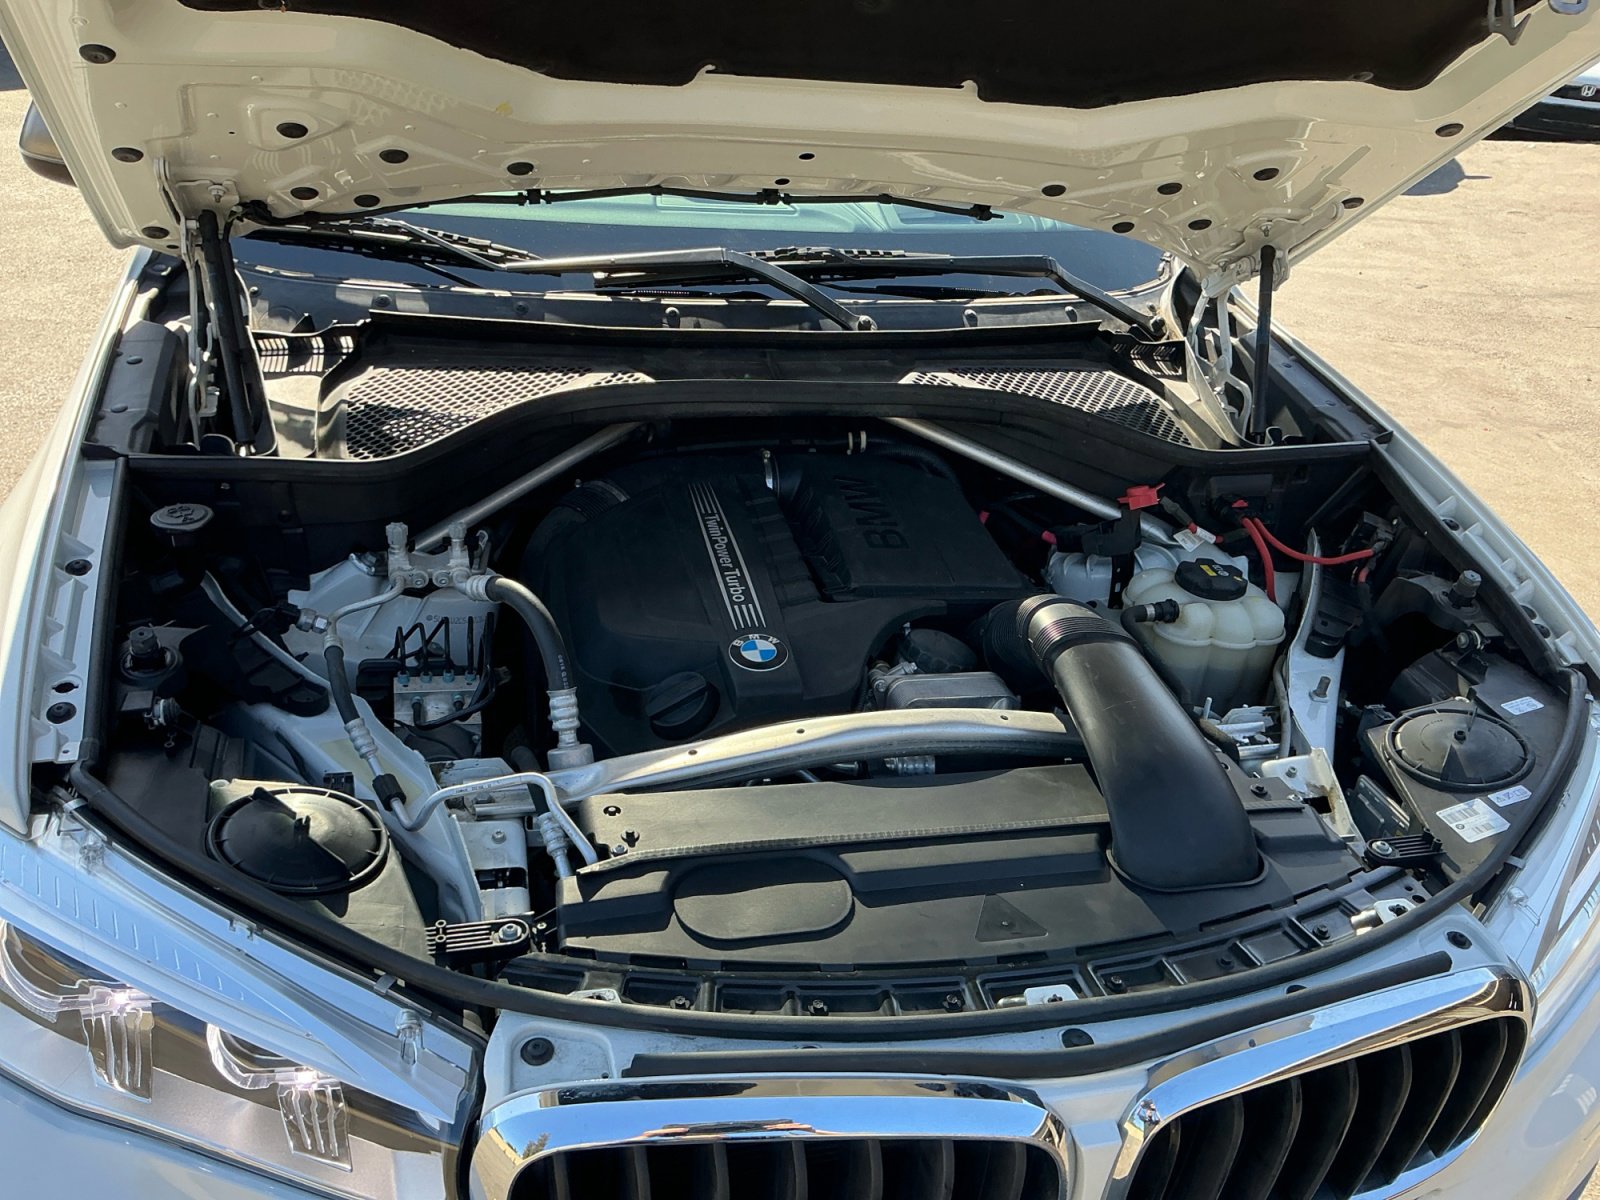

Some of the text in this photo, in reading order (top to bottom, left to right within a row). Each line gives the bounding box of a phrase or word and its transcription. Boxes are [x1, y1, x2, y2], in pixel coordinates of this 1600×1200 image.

[832, 474, 909, 548] BMW
[704, 513, 746, 603] TwinPower Turbo
[732, 634, 780, 647] BMW
